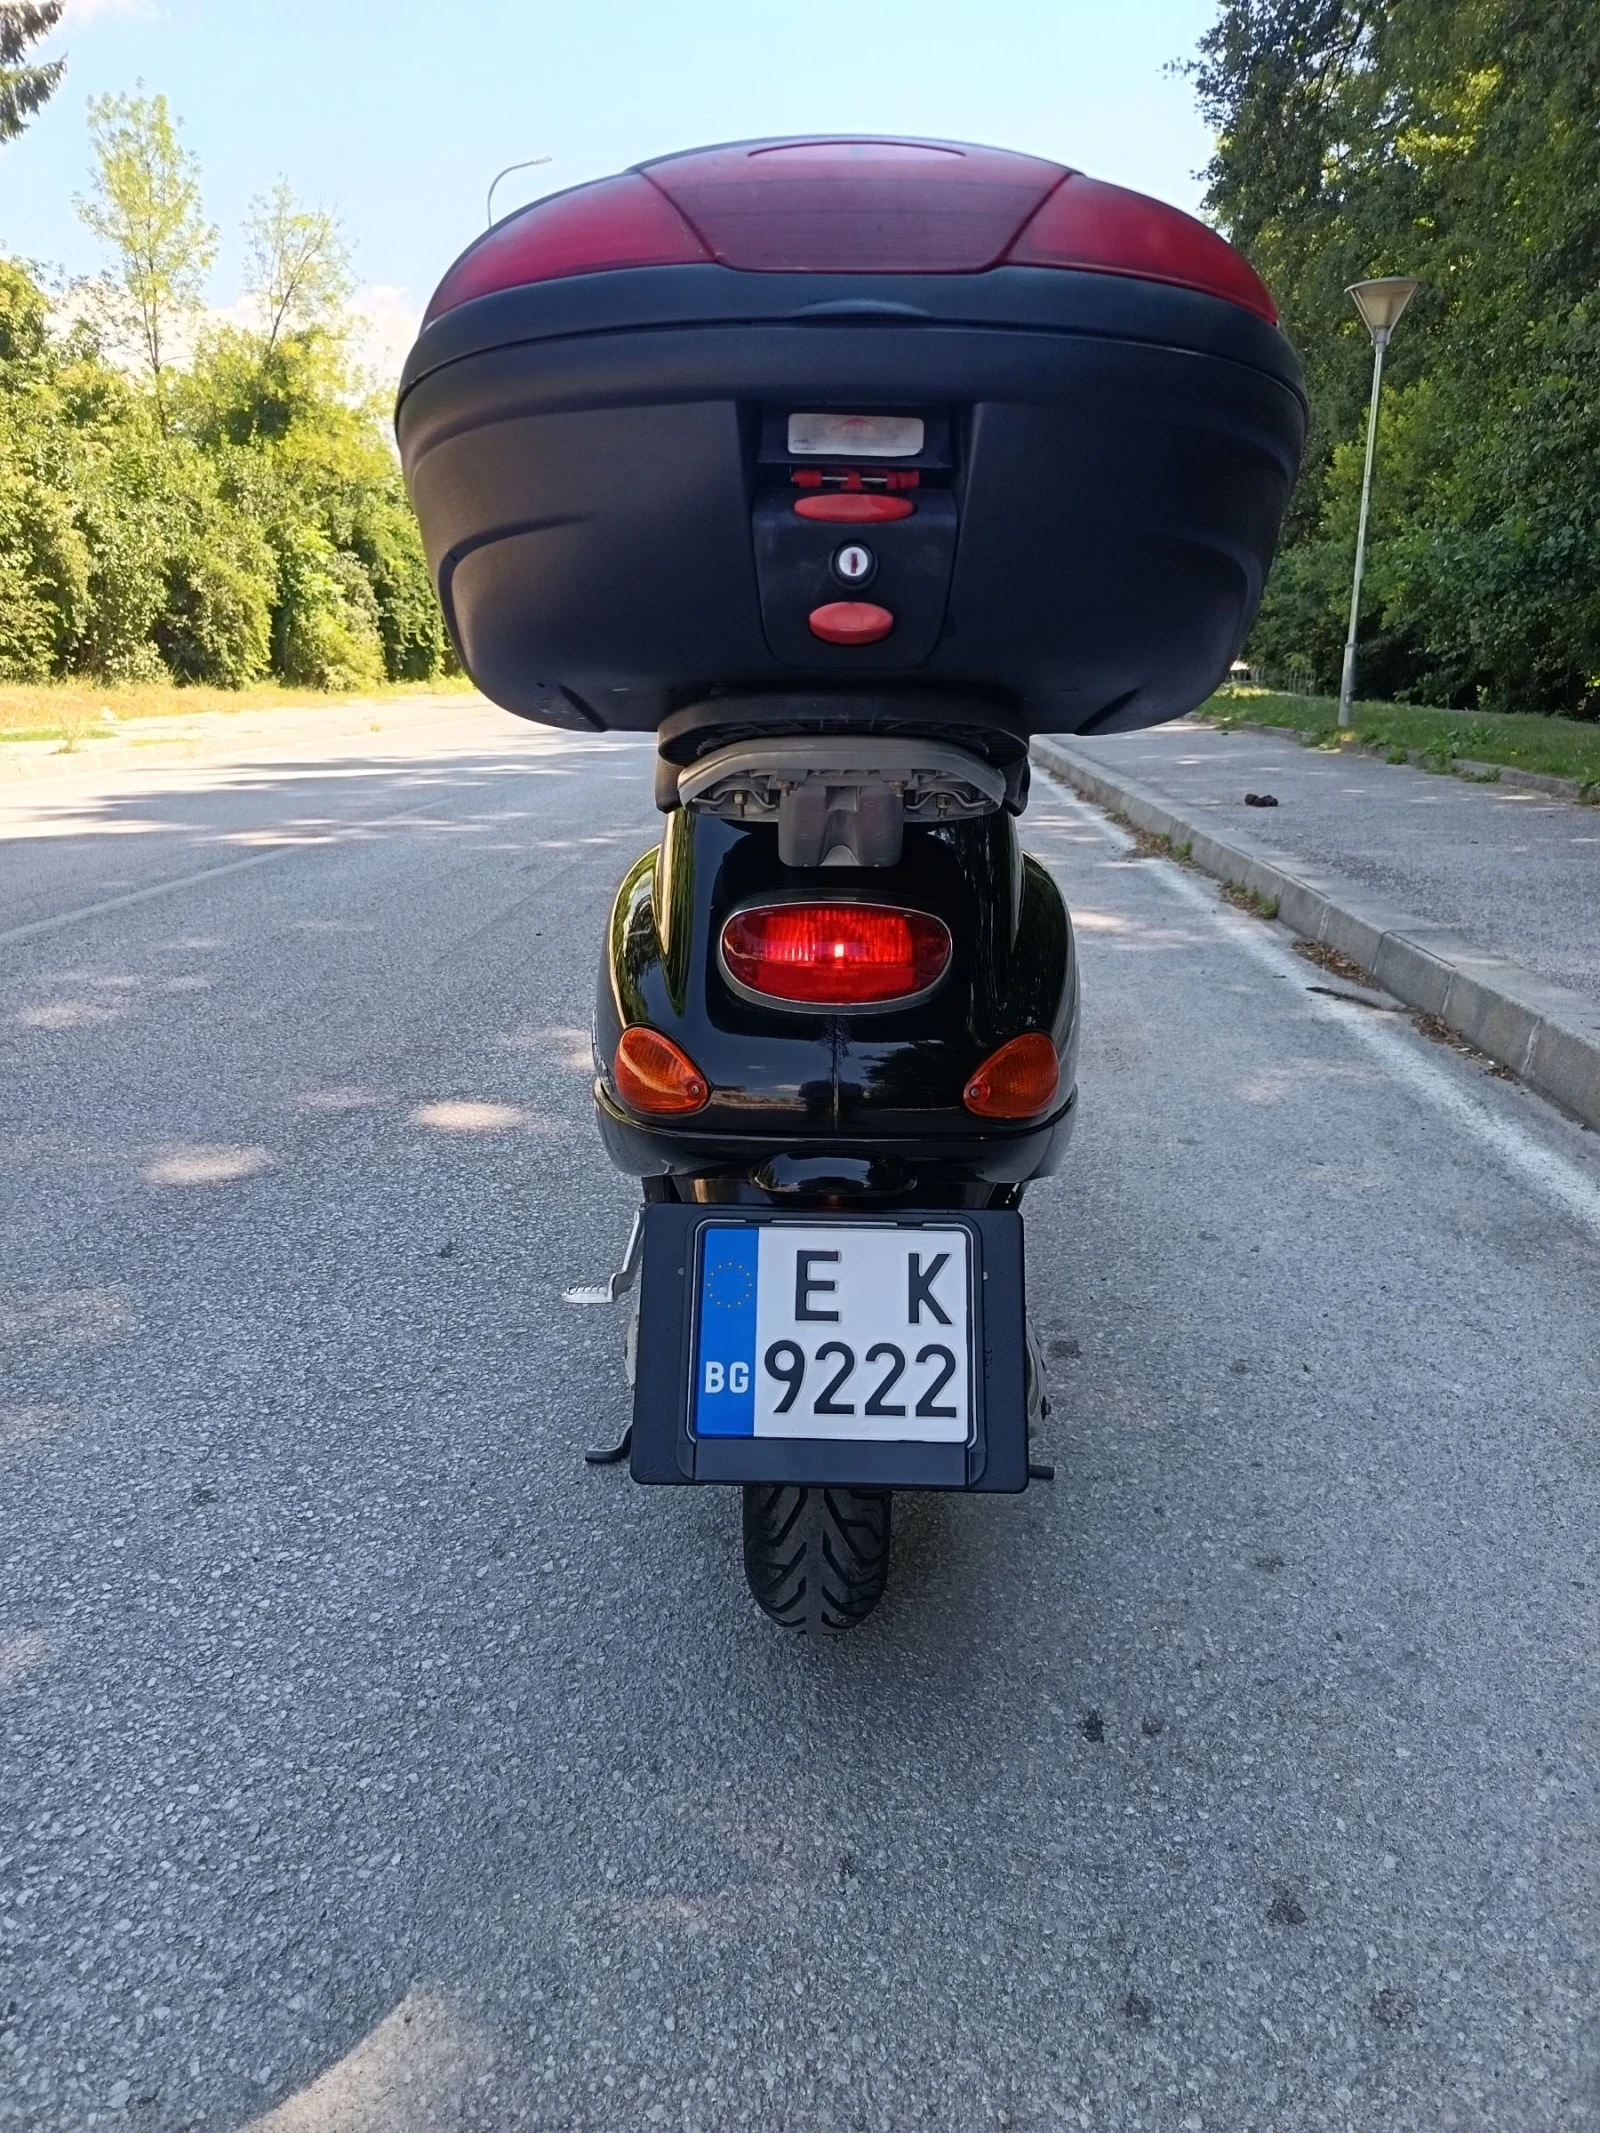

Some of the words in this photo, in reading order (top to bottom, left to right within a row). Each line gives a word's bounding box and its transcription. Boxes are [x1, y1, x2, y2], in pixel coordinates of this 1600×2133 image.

[794, 1249, 840, 1322] E
[908, 1252, 953, 1325] K
[705, 1361, 749, 1393] BG
[764, 1339, 957, 1418] 9222
